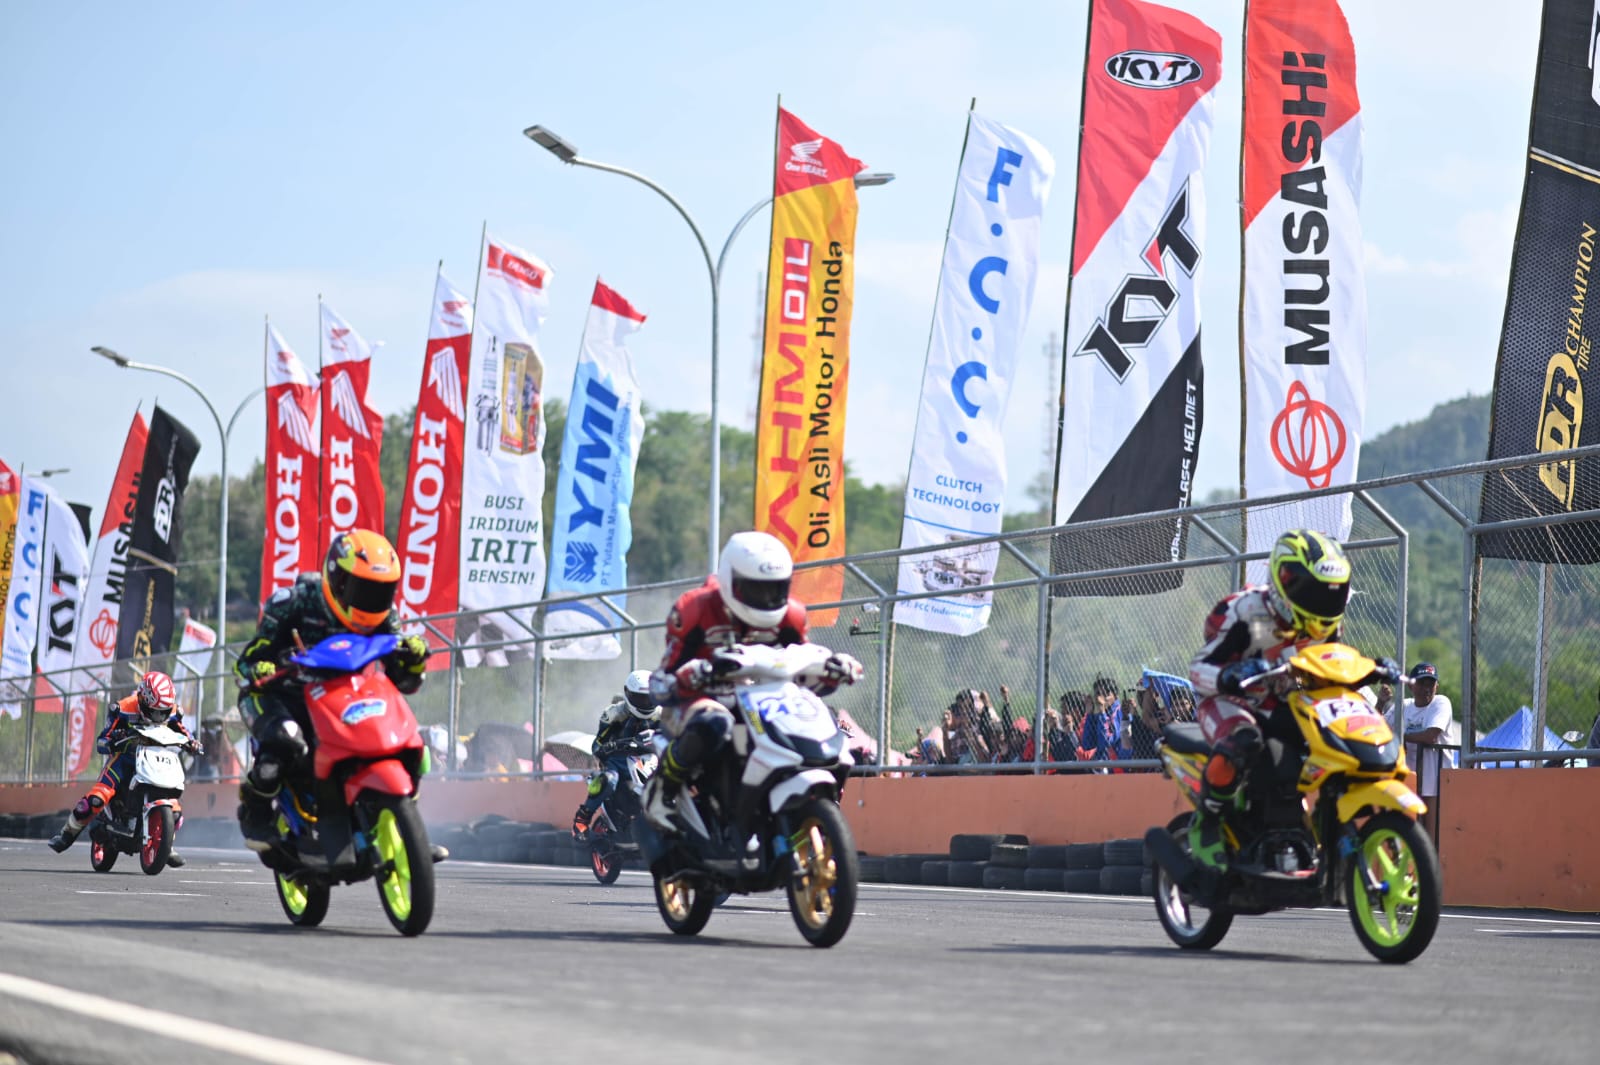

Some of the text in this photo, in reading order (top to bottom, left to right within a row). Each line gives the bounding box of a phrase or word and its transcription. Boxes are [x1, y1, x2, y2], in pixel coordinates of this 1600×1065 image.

[1116, 56, 1192, 81] KYT
[1281, 50, 1330, 366] MUSASHI
[1073, 175, 1203, 385] KYT
[1565, 221, 1598, 356] CHAMPION
[1577, 335, 1592, 372] TIRE
[808, 241, 843, 548] Oli Asli Motor Honda
[330, 435, 358, 542] HO
[568, 377, 620, 534] YMI
[935, 474, 983, 494] CLUTCH
[1171, 517, 1182, 563] ORLD
[1183, 379, 1198, 453] HELMET
[272, 452, 303, 595] HON
[399, 411, 447, 637] HONDA
[468, 516, 539, 534] IRIDIUM
[484, 494, 525, 511] BUSI
[912, 487, 1001, 514] TECHNOLOGY
[467, 537, 538, 565] IRIT
[467, 569, 536, 585] BENSIN!
[600, 571, 611, 586] PT
[603, 528, 615, 567] Yutaka
[46, 543, 79, 657] KYT
